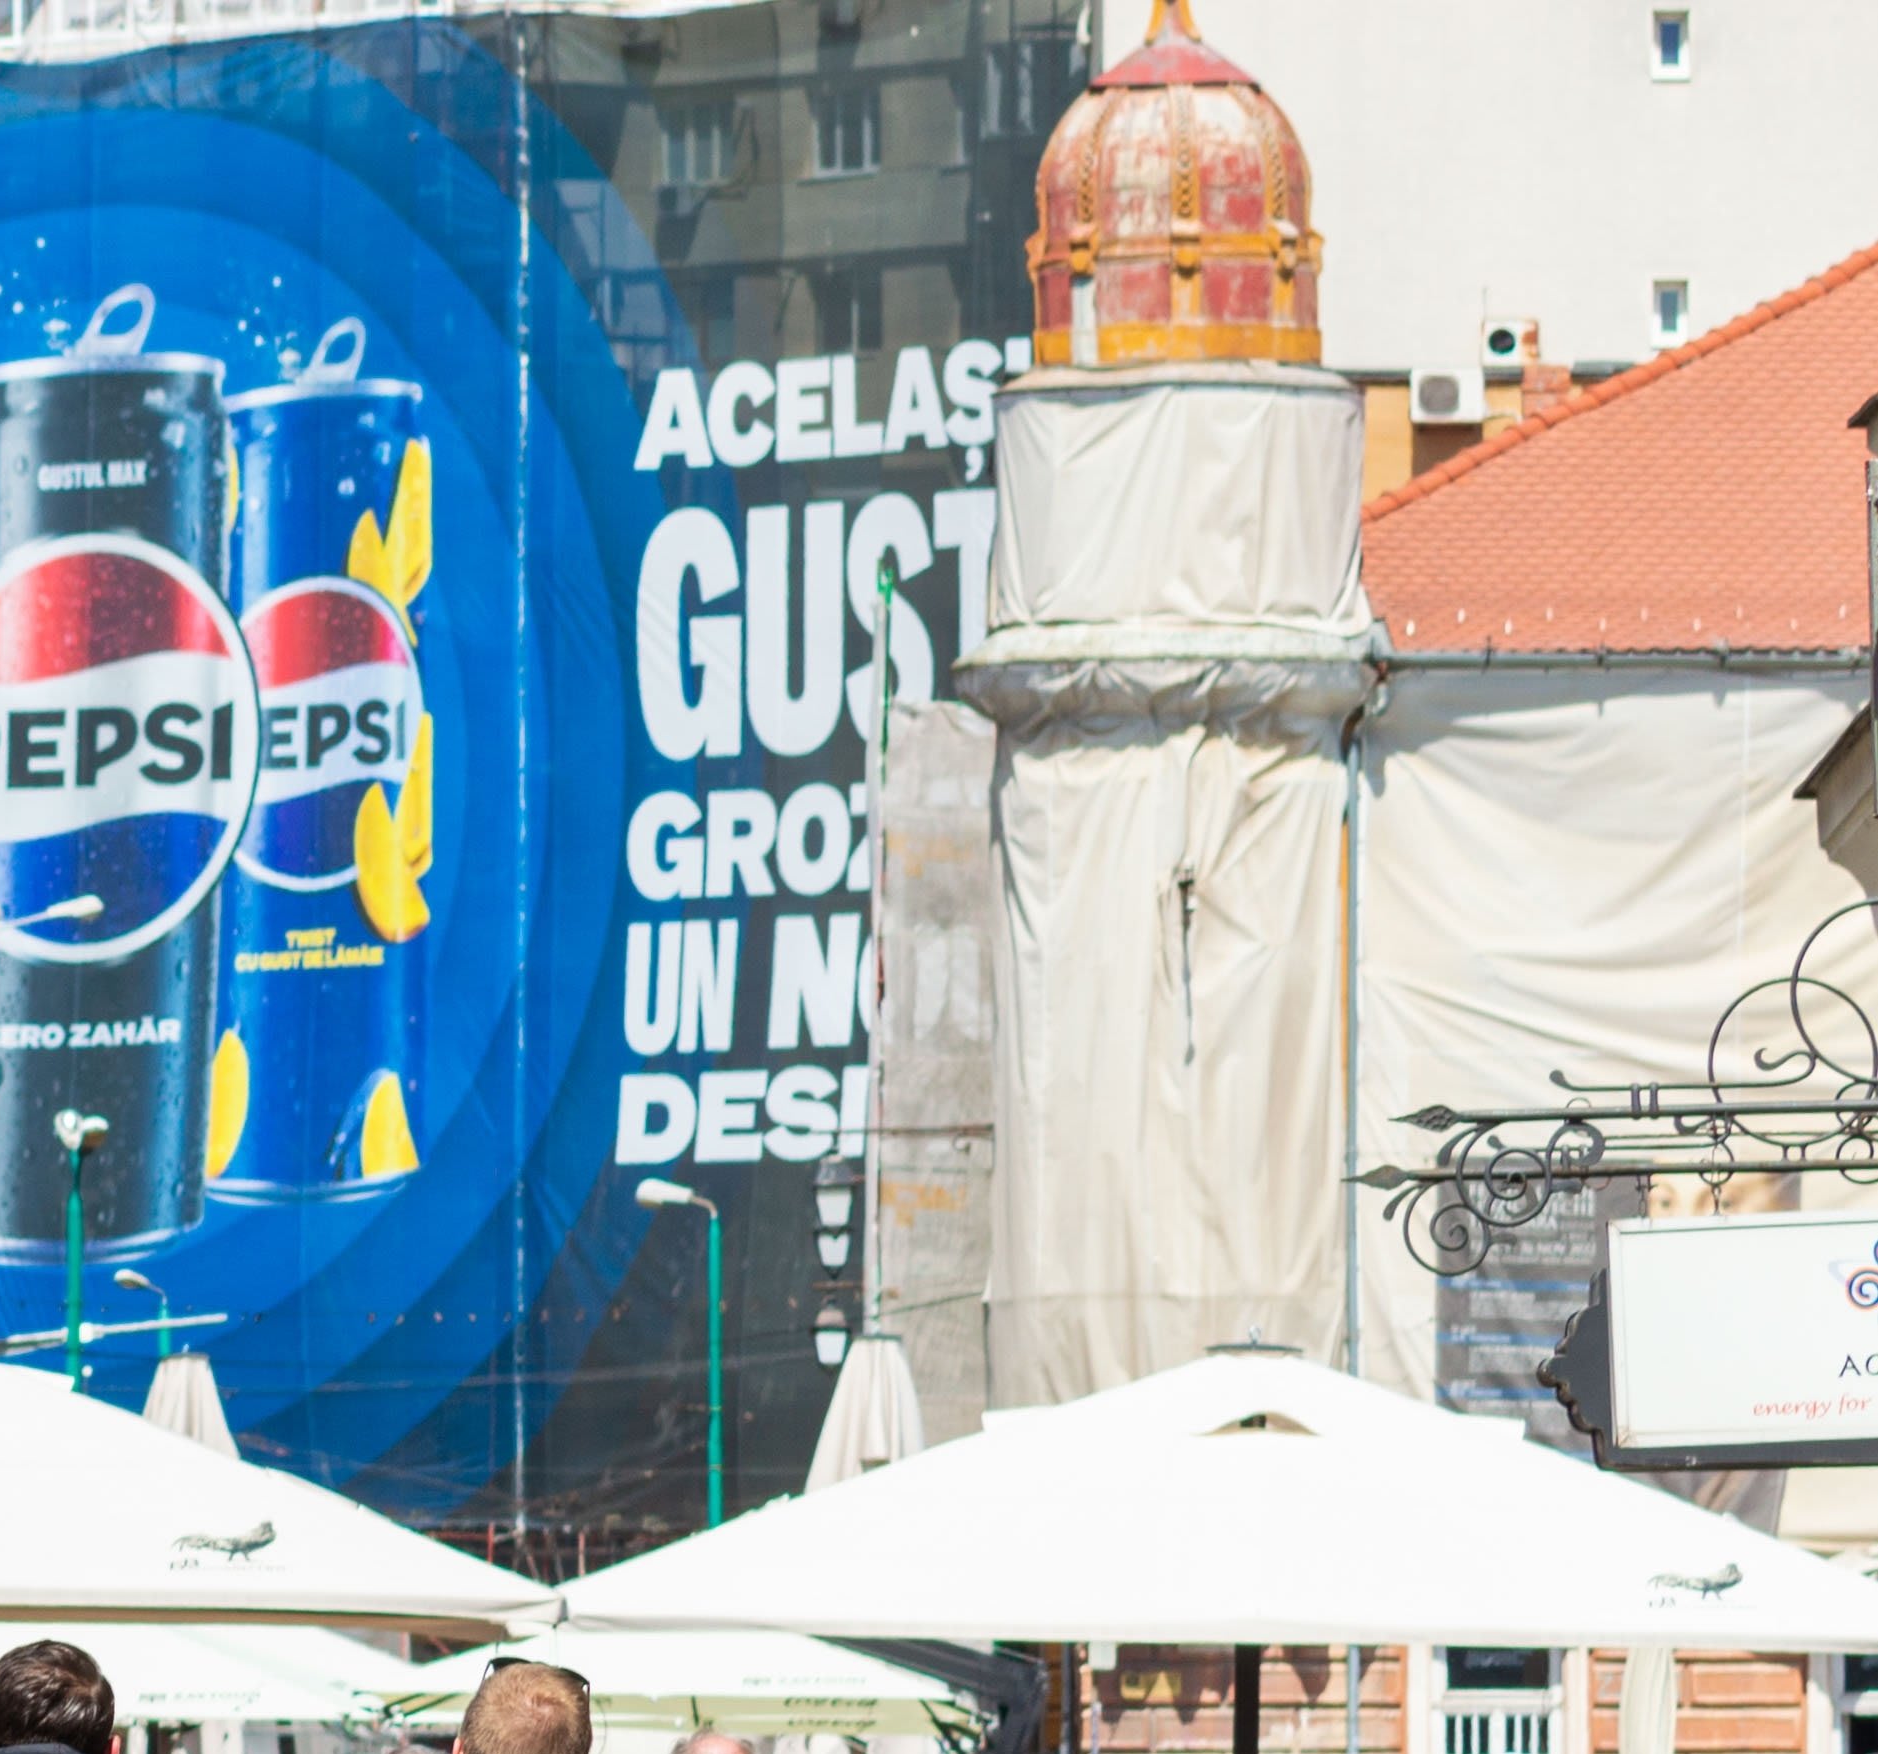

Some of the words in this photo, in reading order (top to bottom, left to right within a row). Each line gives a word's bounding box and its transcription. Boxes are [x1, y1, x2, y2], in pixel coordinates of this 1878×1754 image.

[259, 698, 405, 770] EPSI
[623, 918, 739, 1056] UN
[1753, 1399, 1832, 1420] energy
[1838, 1392, 1871, 1416] for
